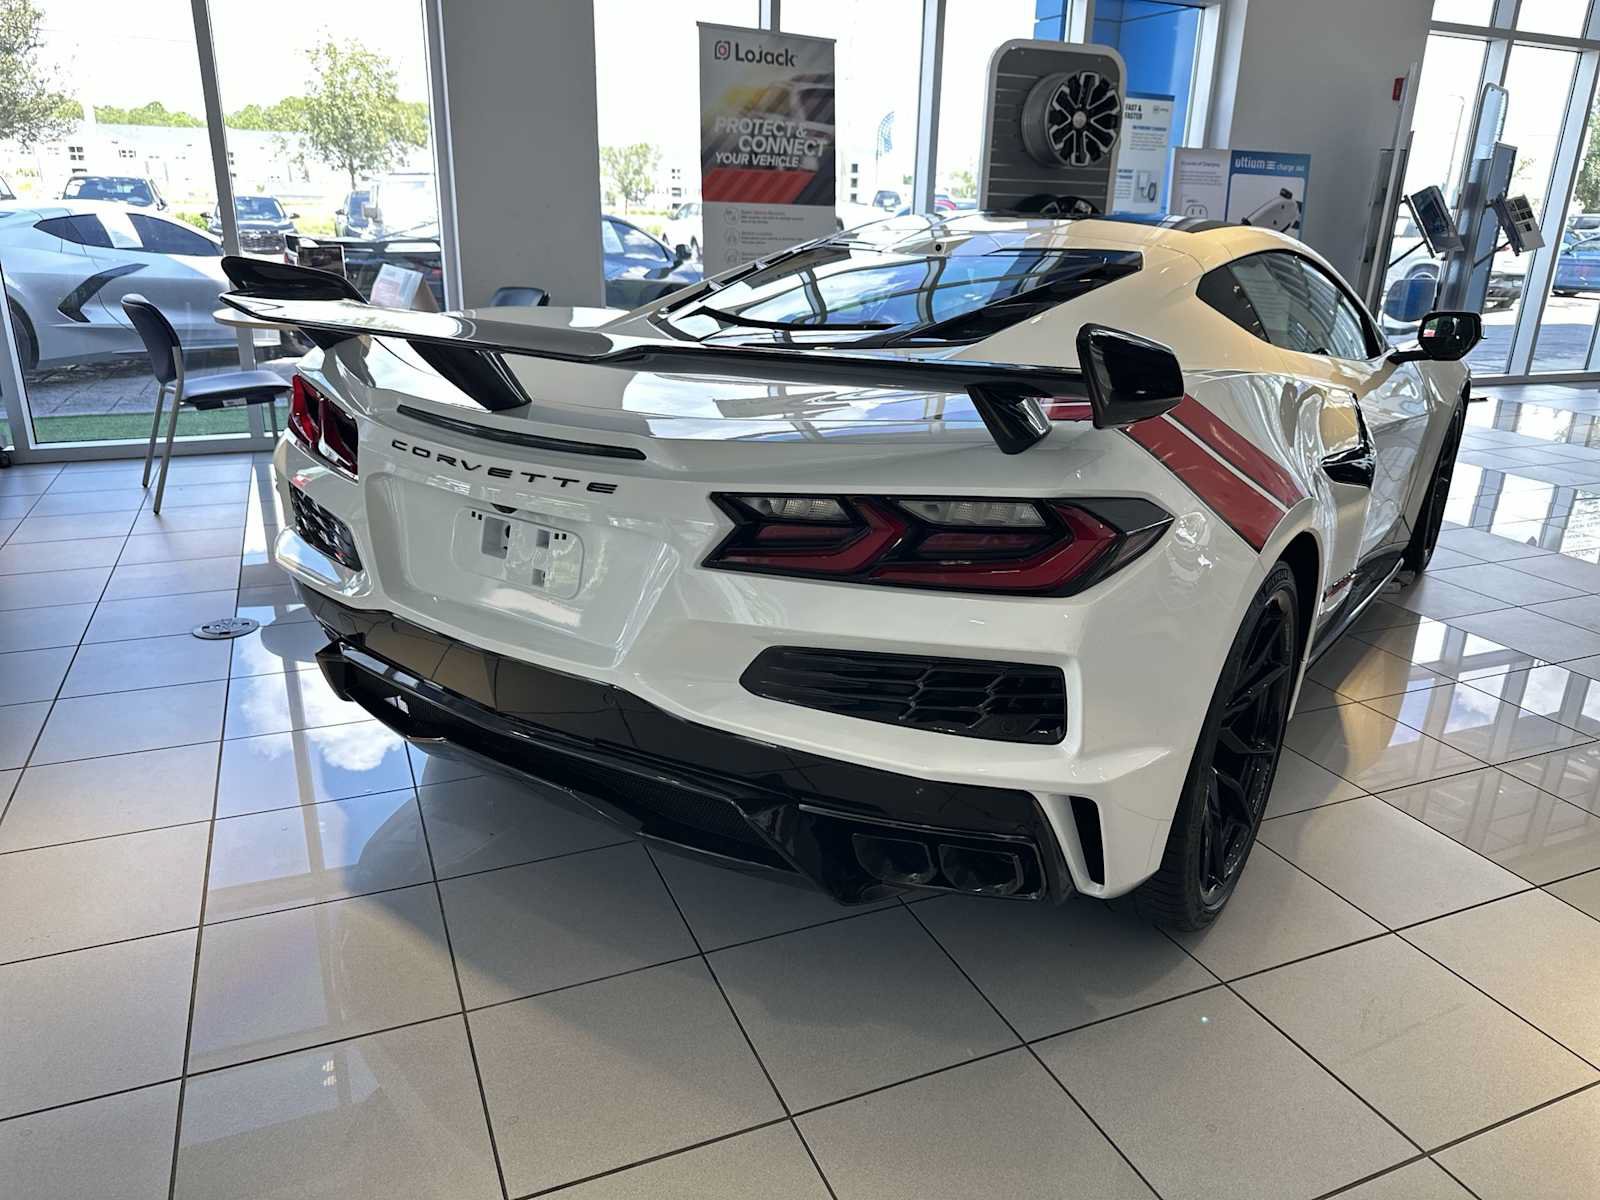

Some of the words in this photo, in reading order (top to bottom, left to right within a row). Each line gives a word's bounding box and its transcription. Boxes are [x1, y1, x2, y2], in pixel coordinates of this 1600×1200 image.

[1125, 103, 1138, 112] FAST
[1124, 112, 1143, 120] FASTER
[714, 115, 796, 137] PROTECT
[796, 124, 808, 138] &
[738, 135, 828, 157] CONNECT
[715, 152, 749, 166] YOUR
[752, 154, 800, 168] VEHICLE
[1234, 155, 1266, 170] ultium
[391, 439, 619, 494] CORVETTE
